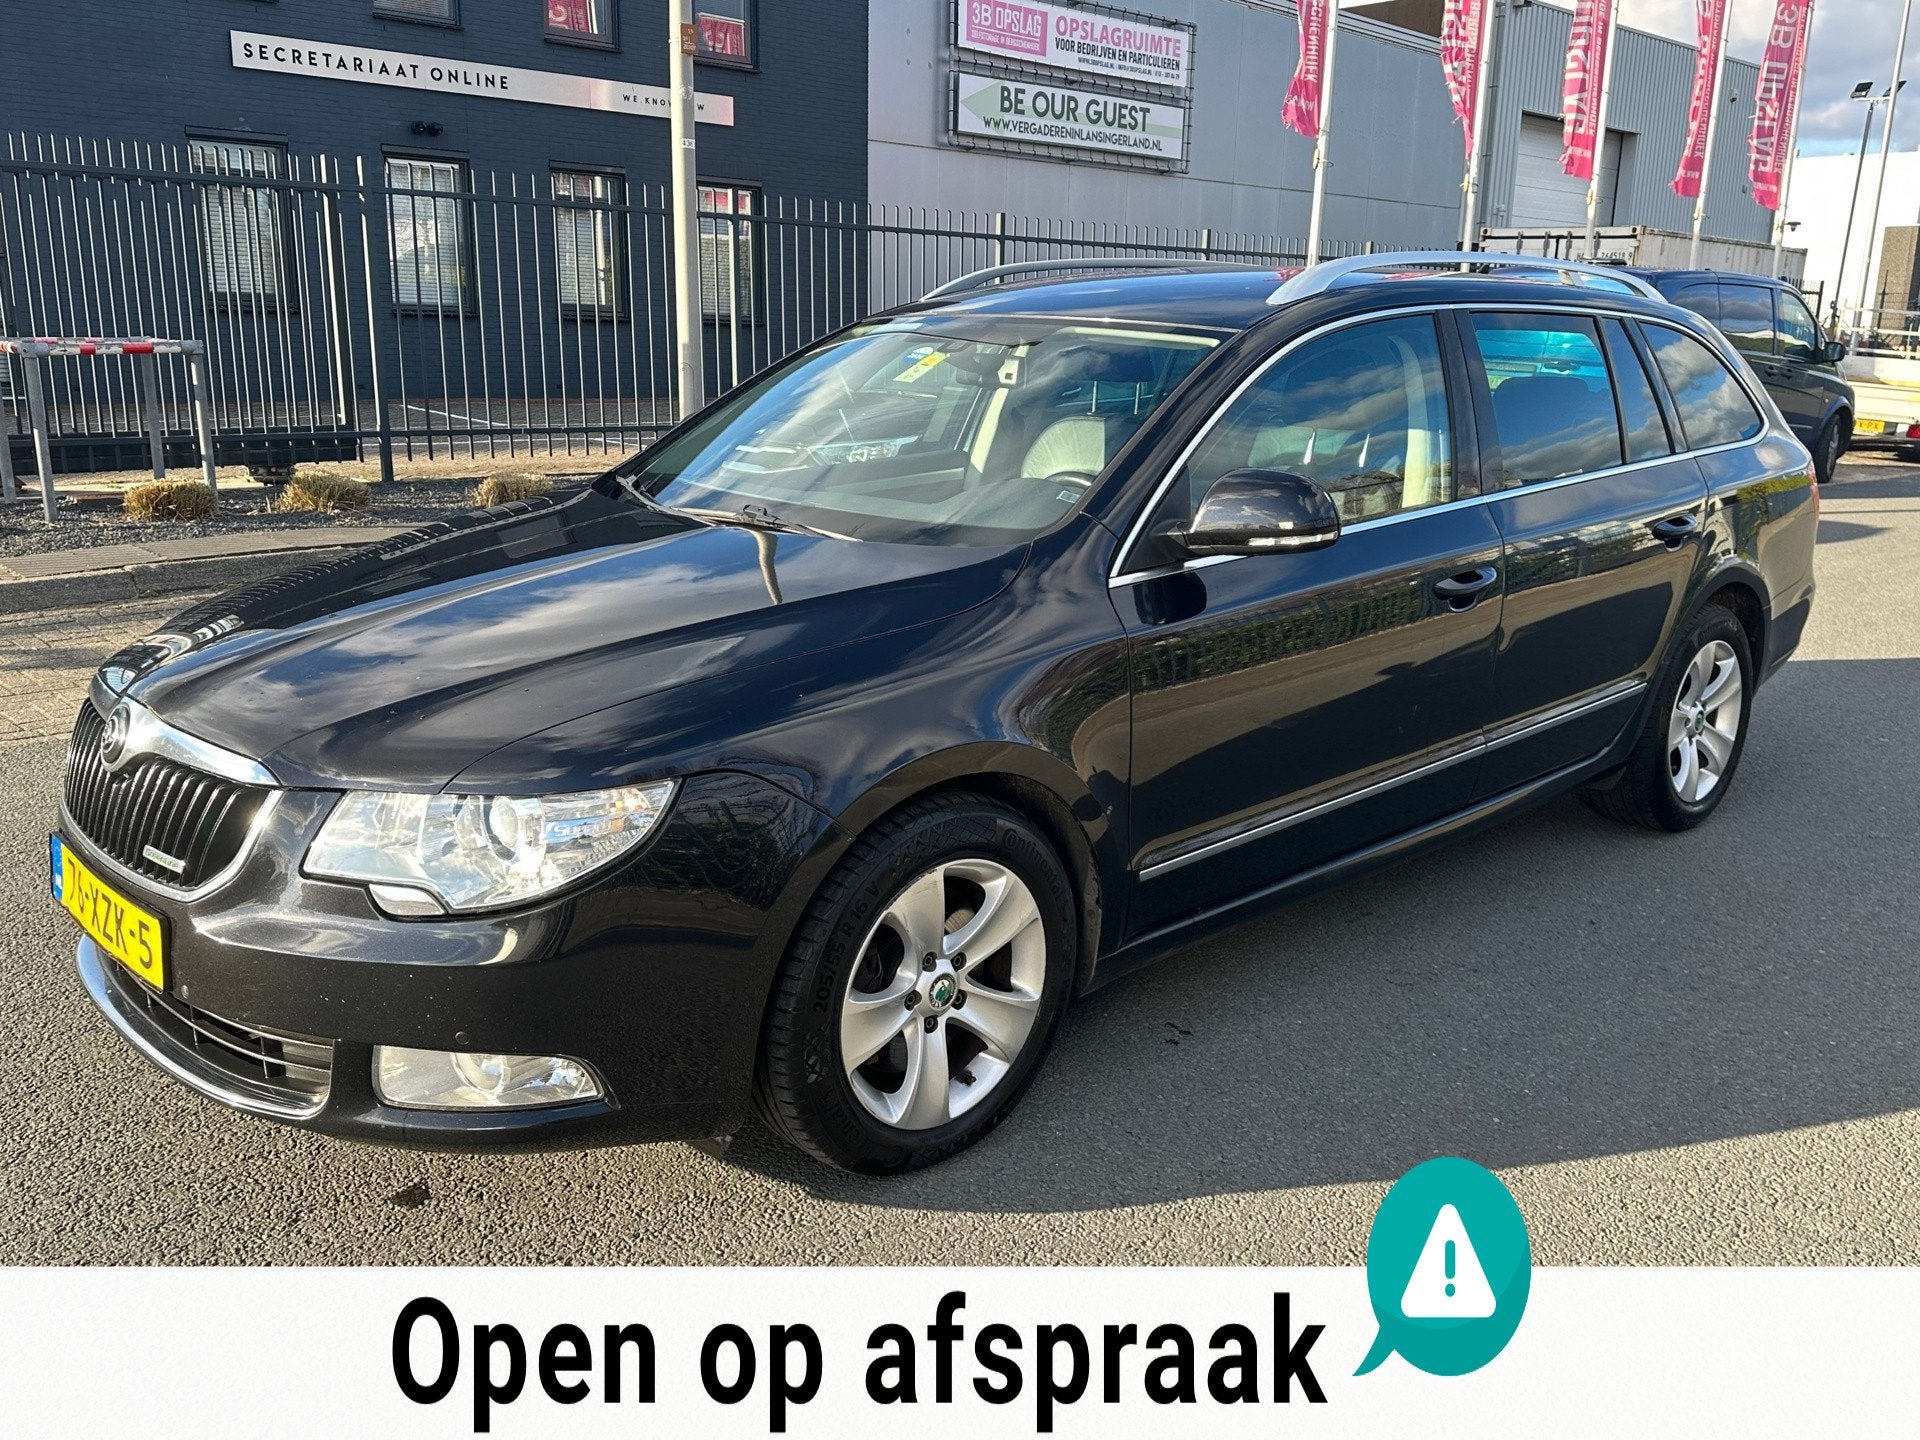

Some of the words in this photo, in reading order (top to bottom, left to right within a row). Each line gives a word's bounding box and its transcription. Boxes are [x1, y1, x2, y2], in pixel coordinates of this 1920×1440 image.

[972, 2, 992, 26] 3B
[996, 7, 1041, 36] OPSLAG
[1055, 15, 1182, 57] OPSLAGRUIMTE
[243, 42, 419, 79] SECRETARIAAT
[430, 67, 509, 90] ONLINE
[1055, 37, 1075, 53] VOOR
[1077, 40, 1117, 60] BEDRIJVEN
[1118, 49, 1127, 62] EN
[1129, 52, 1180, 71] PARTICULIEREN
[645, 97, 671, 106] KNO
[1000, 85, 1026, 115] BE
[1032, 91, 1079, 123] OUR
[1085, 99, 1150, 132] GUEST
[983, 116, 1163, 151] WWW.VERGADERENINLANSINGERLAND.NL
[67, 857, 153, 969] 76-XZK-5
